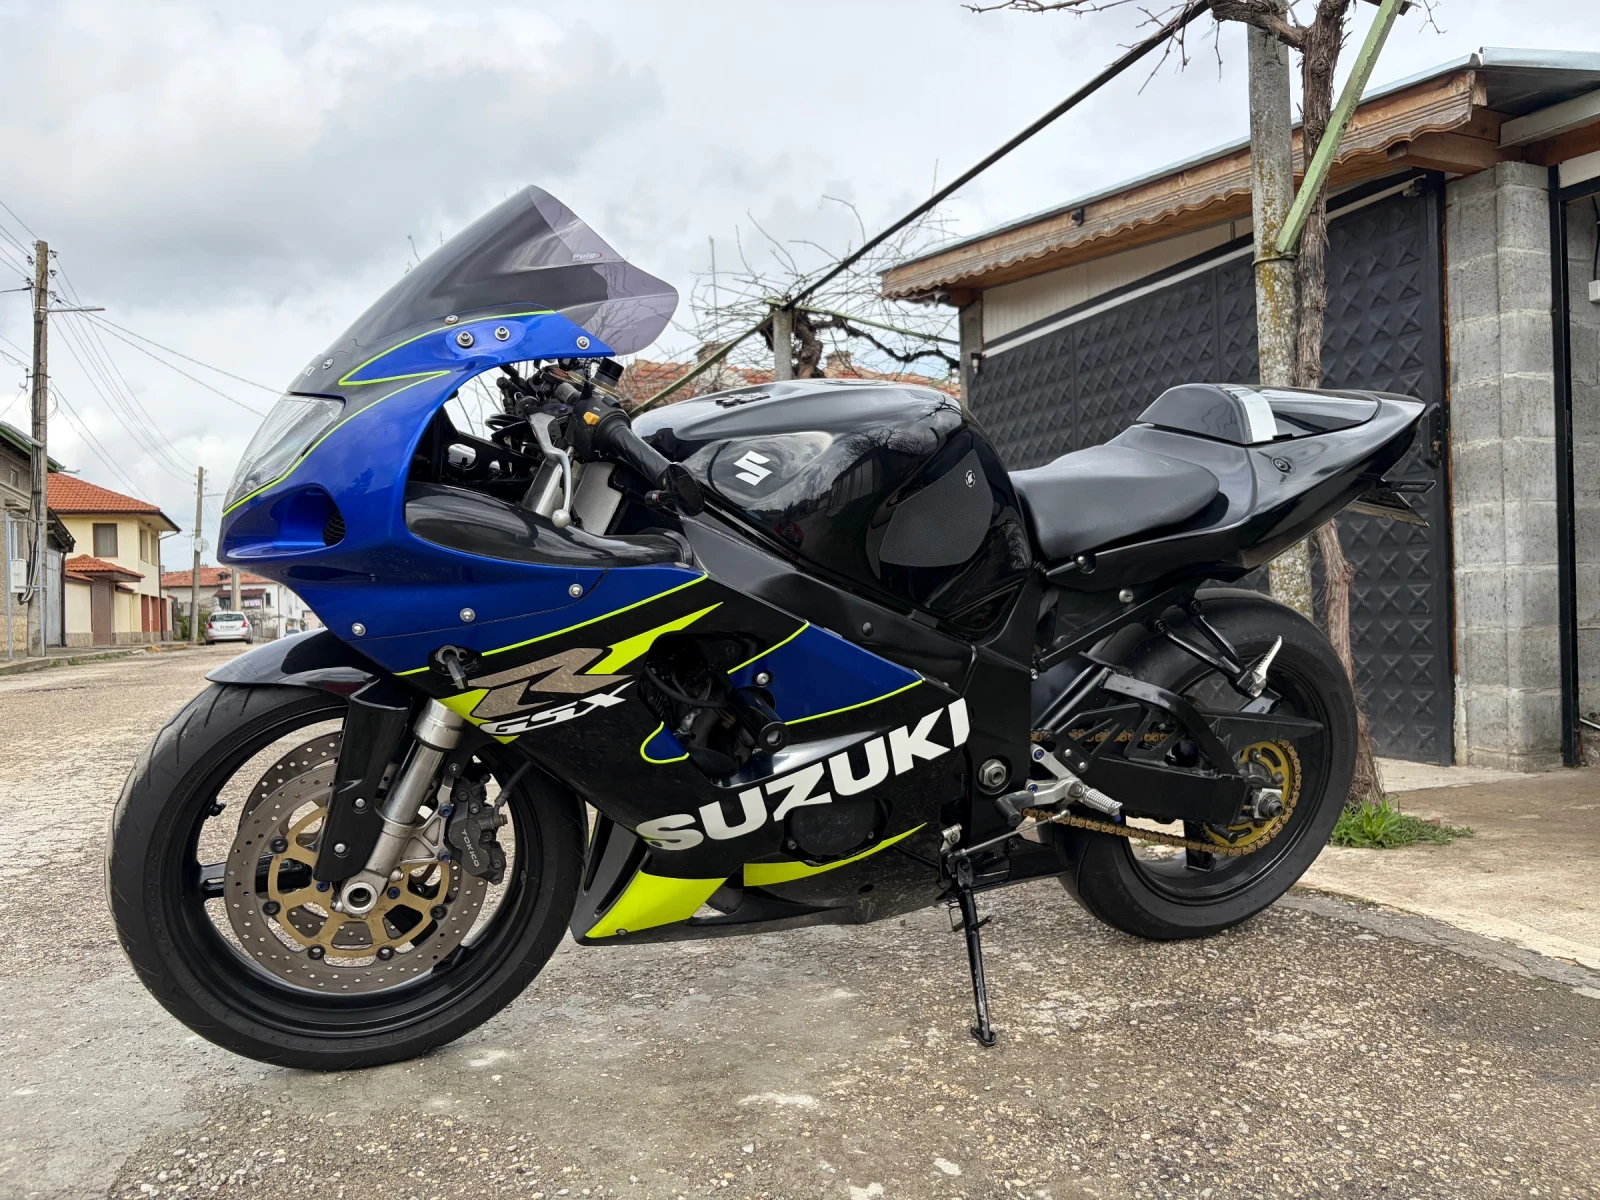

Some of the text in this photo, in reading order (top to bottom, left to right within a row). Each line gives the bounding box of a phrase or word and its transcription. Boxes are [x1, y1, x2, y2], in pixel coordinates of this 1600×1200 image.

[479, 680, 636, 735] GSX
[635, 697, 969, 852] SUZUKI
[461, 828, 480, 867] TOKICO
